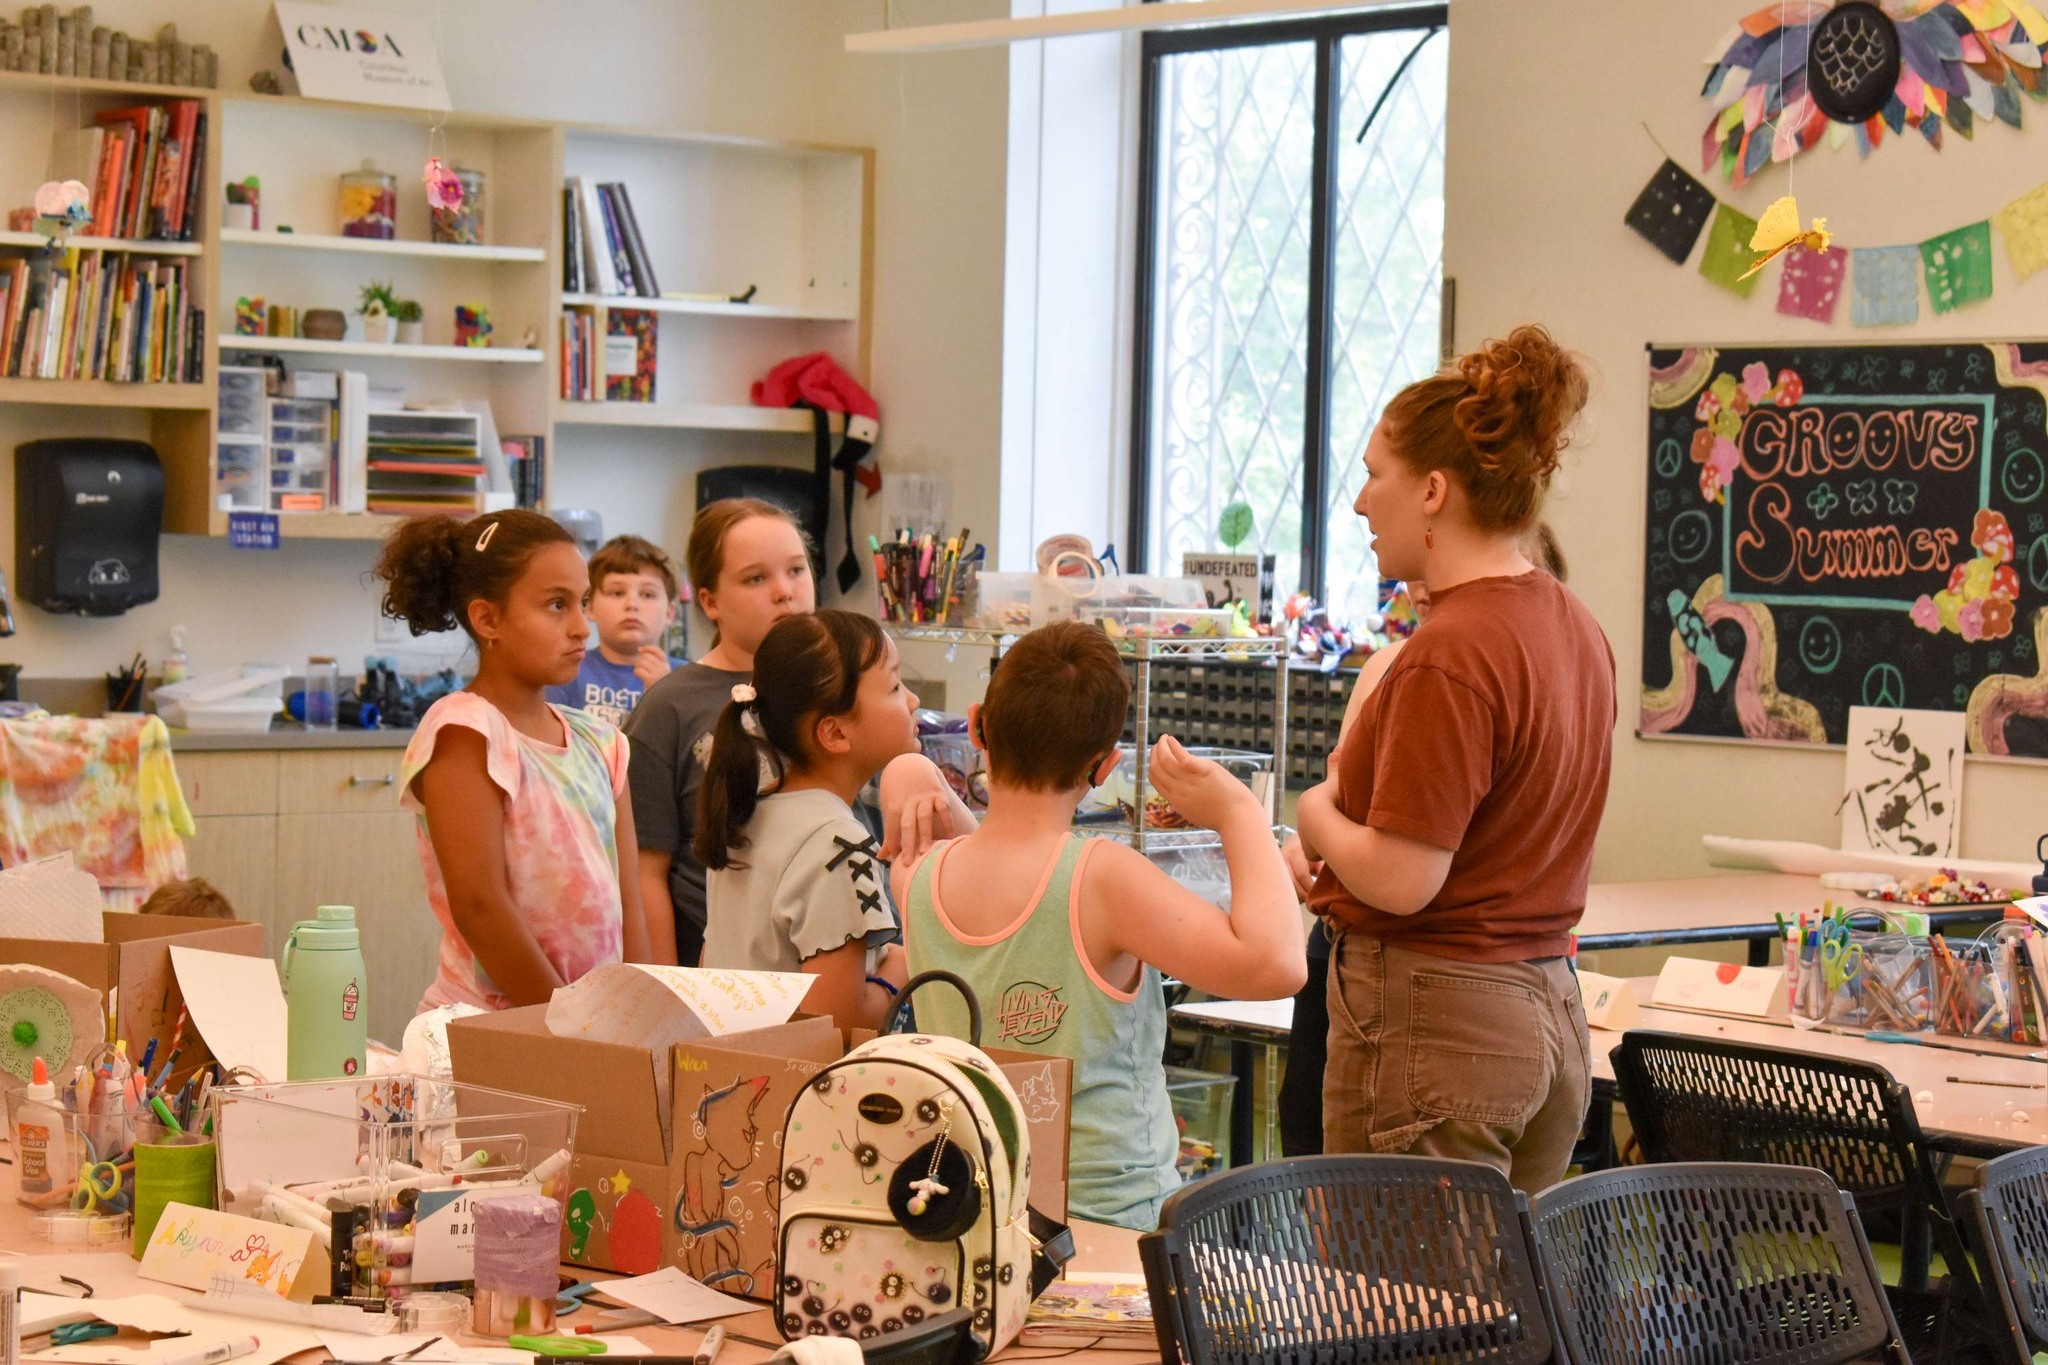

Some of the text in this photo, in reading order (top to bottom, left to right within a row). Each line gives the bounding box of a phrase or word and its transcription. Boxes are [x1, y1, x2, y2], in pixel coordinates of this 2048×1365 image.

[1738, 407, 1978, 481] GROOVY
[1735, 482, 1958, 583] Summer
[1189, 559, 1258, 578] UNDEFEATED
[998, 986, 1062, 1016] LIVING
[998, 1001, 1068, 1041] LEGEND
